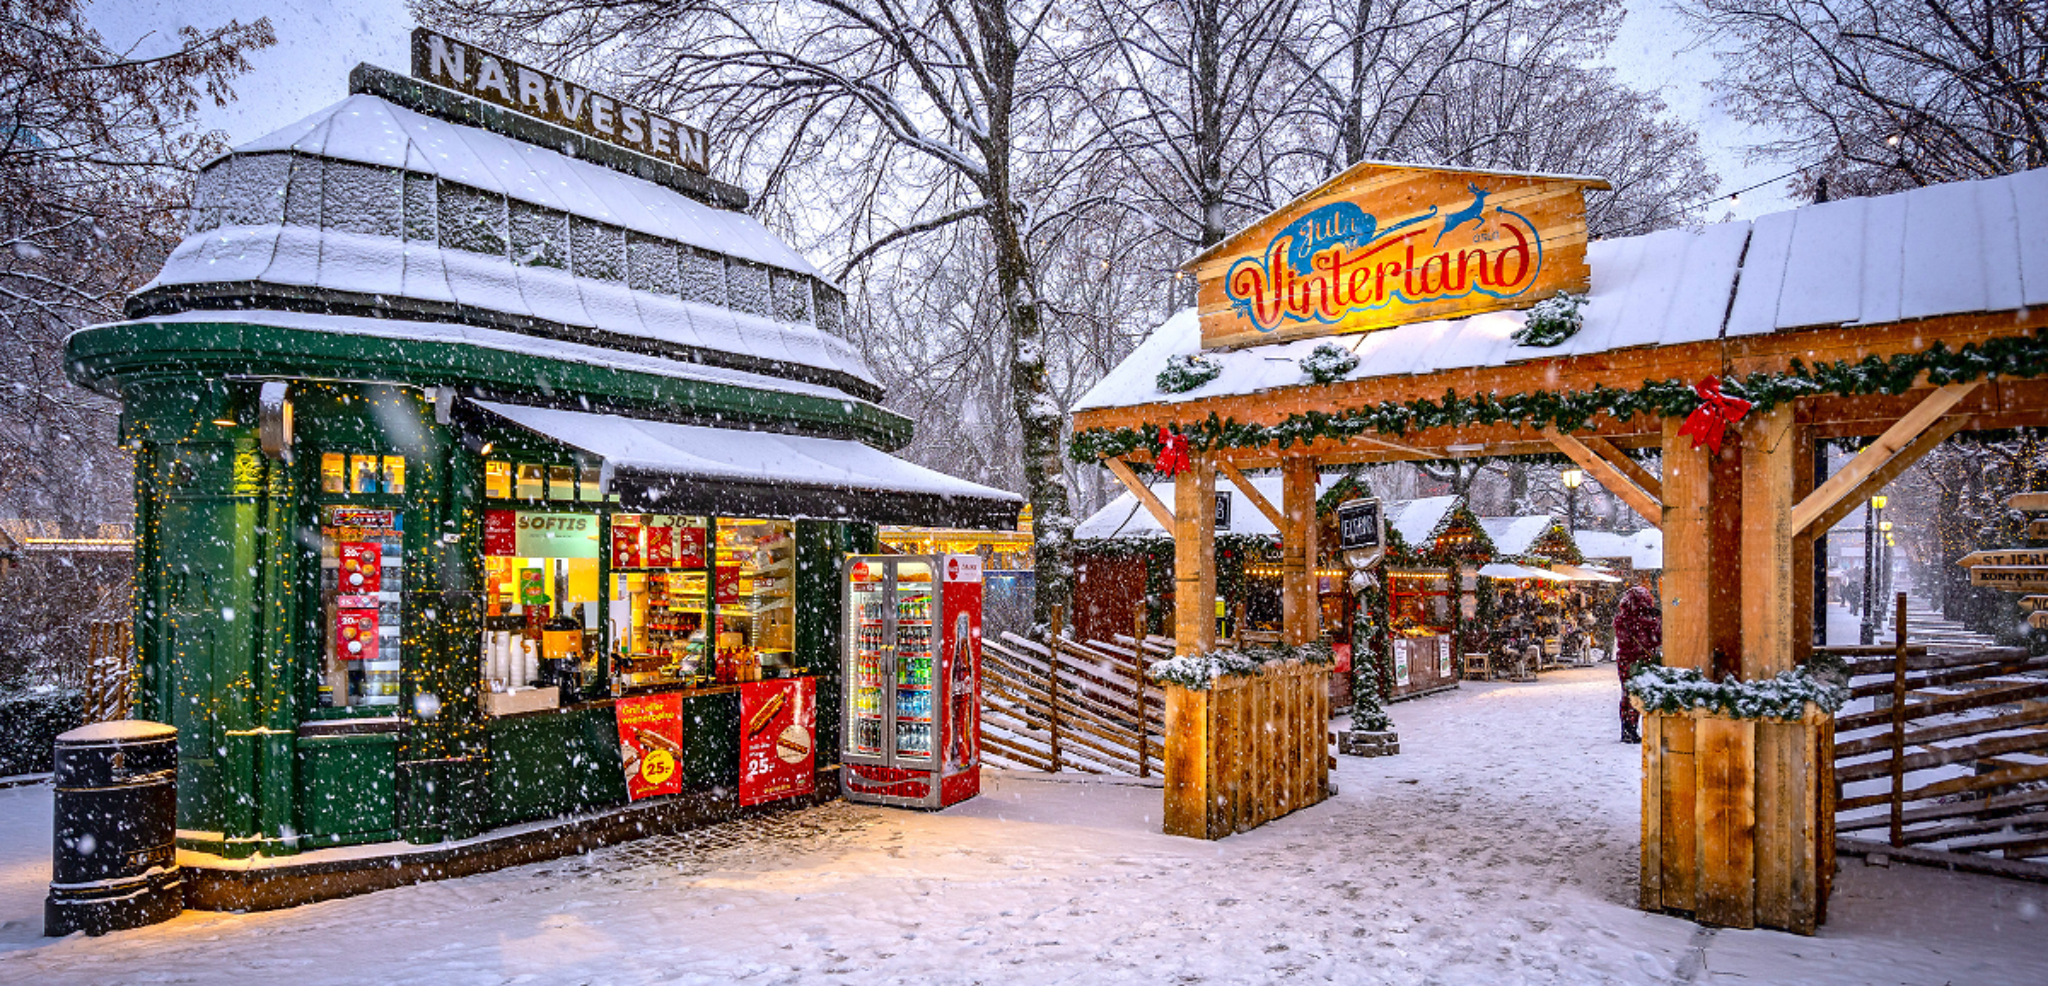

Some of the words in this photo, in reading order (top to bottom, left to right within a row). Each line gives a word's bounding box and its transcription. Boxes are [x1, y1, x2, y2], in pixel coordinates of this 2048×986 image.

[428, 34, 708, 167] NARVESEN
[1473, 231, 1500, 243] OSLO
[1235, 222, 1530, 325] Vinterland
[518, 516, 588, 531] SOFTIS
